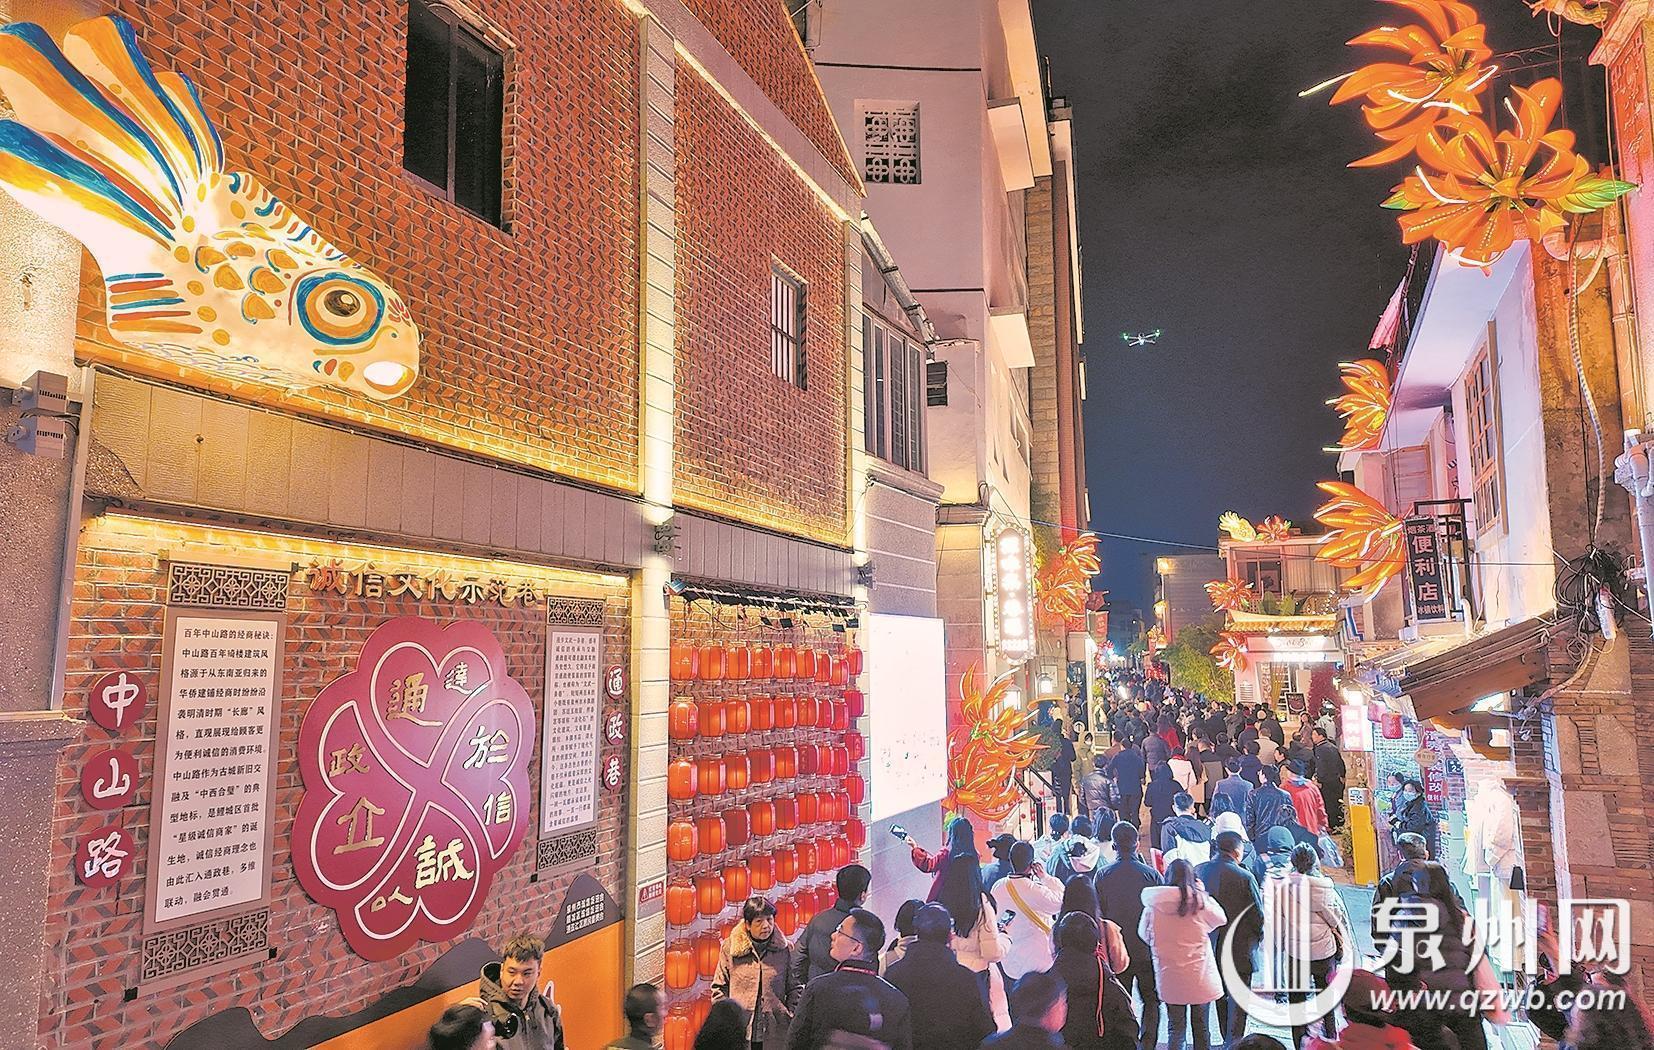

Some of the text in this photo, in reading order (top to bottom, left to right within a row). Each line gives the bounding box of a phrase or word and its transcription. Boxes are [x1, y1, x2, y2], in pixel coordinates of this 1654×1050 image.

[306, 560, 545, 606] 诚信文化示范巷
[1412, 535, 1439, 601] 便利店
[180, 668, 267, 679] 格源于从东南亚归来的
[604, 666, 625, 786] 通政巷
[83, 673, 140, 879] 中山路
[172, 763, 261, 782] 中山路作为古城新旧交
[328, 742, 387, 856] 政企
